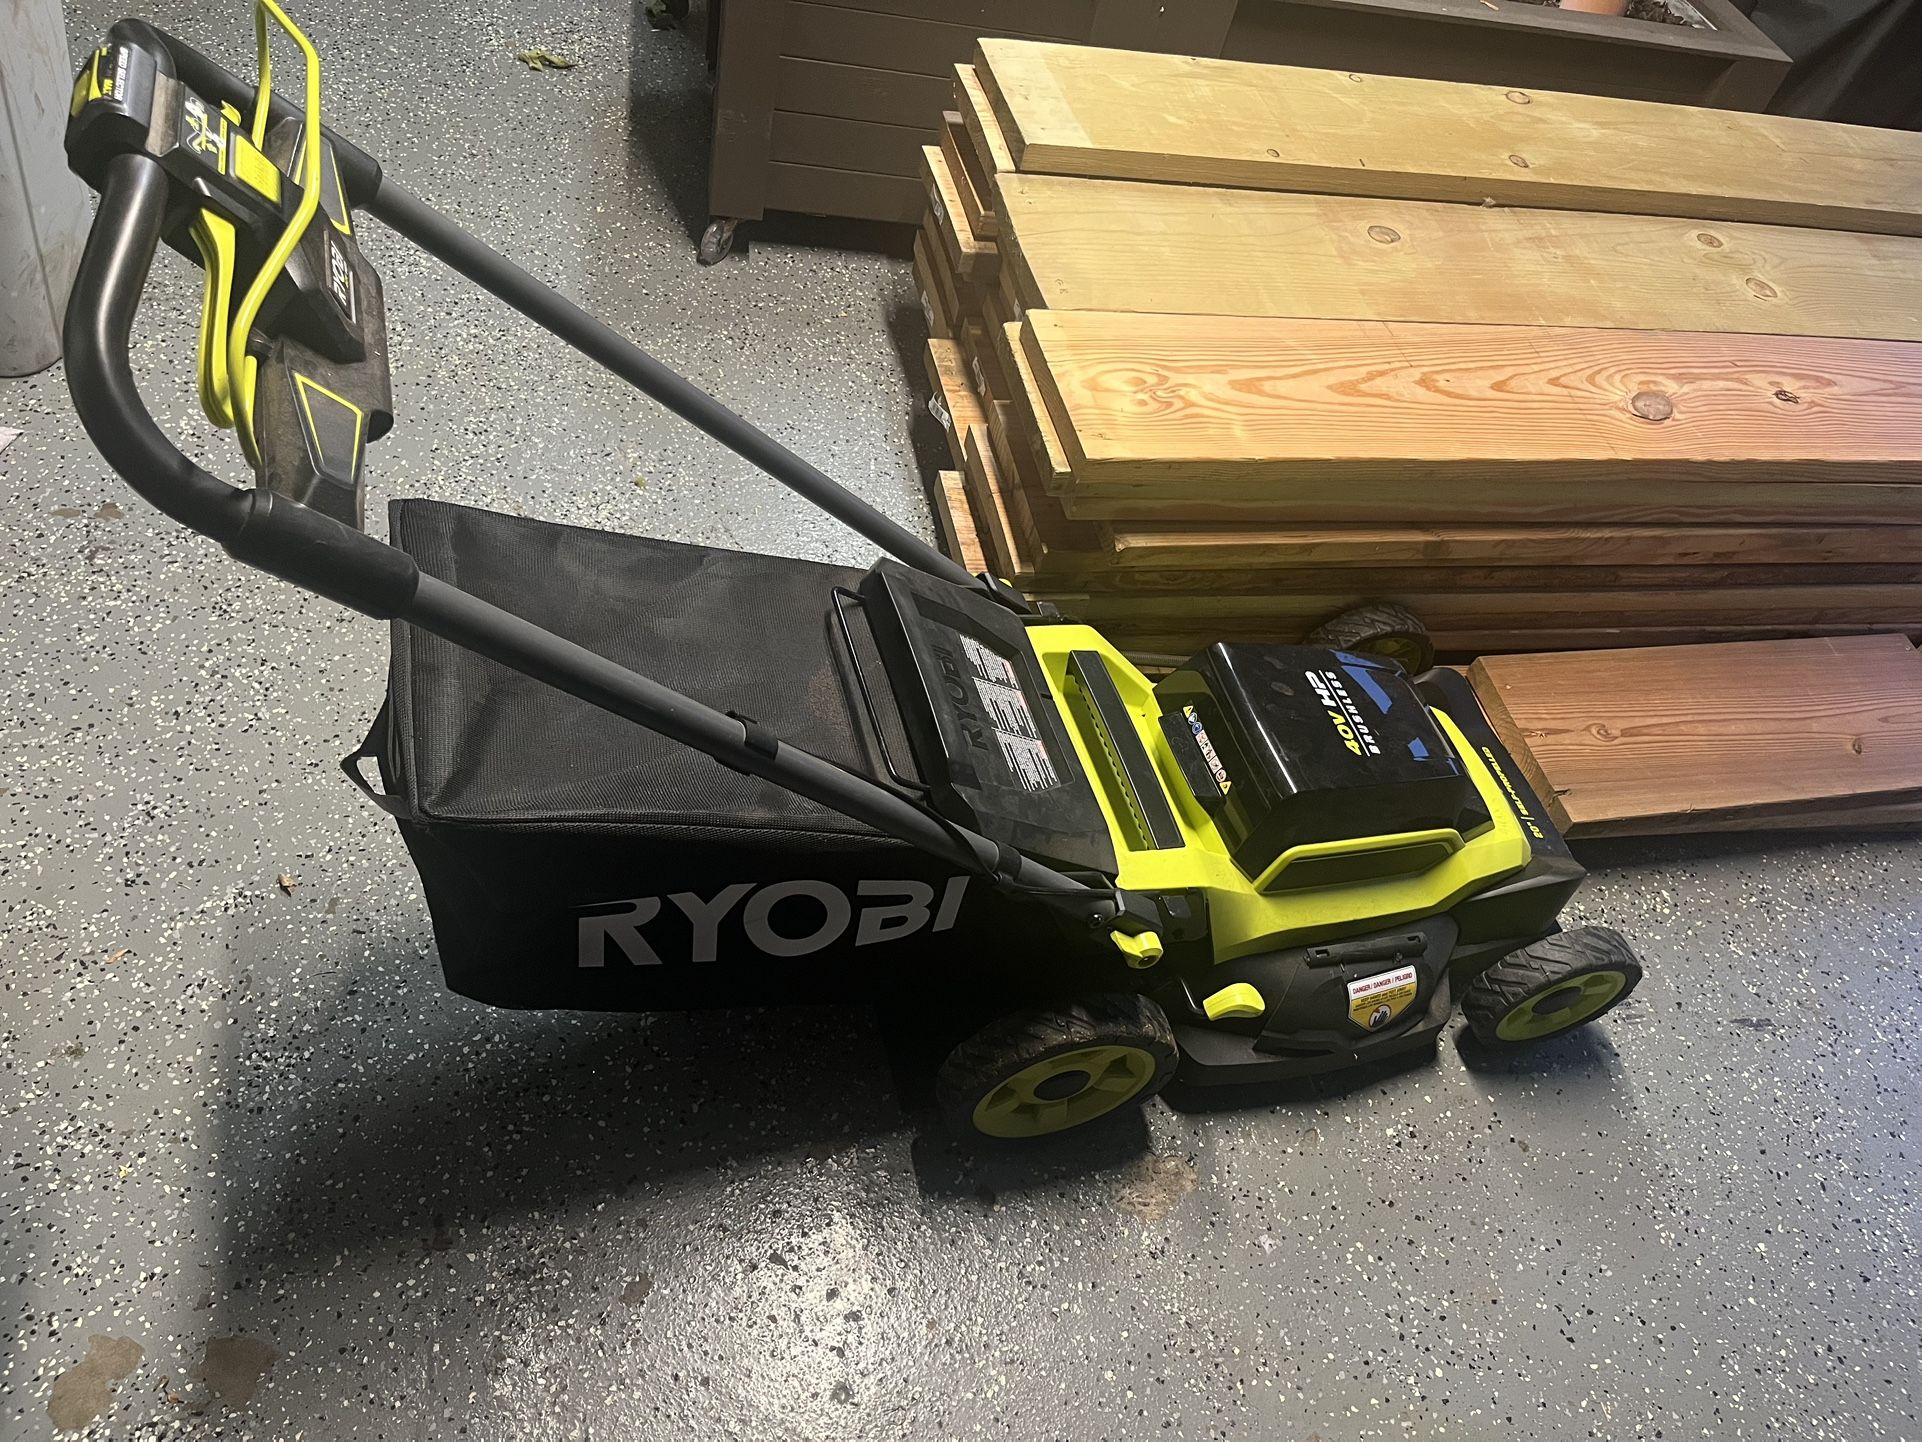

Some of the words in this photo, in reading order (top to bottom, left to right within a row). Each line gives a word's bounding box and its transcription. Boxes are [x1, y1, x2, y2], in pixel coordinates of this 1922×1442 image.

[331, 240, 348, 306] RYOBI
[931, 644, 990, 751] RYOBI
[1305, 671, 1337, 707] HP
[1325, 671, 1381, 755] BRUSHLESS
[1327, 710, 1362, 756] 40V
[1481, 746, 1529, 816] SELF-PROPELLED
[568, 875, 971, 968] RYOBI
